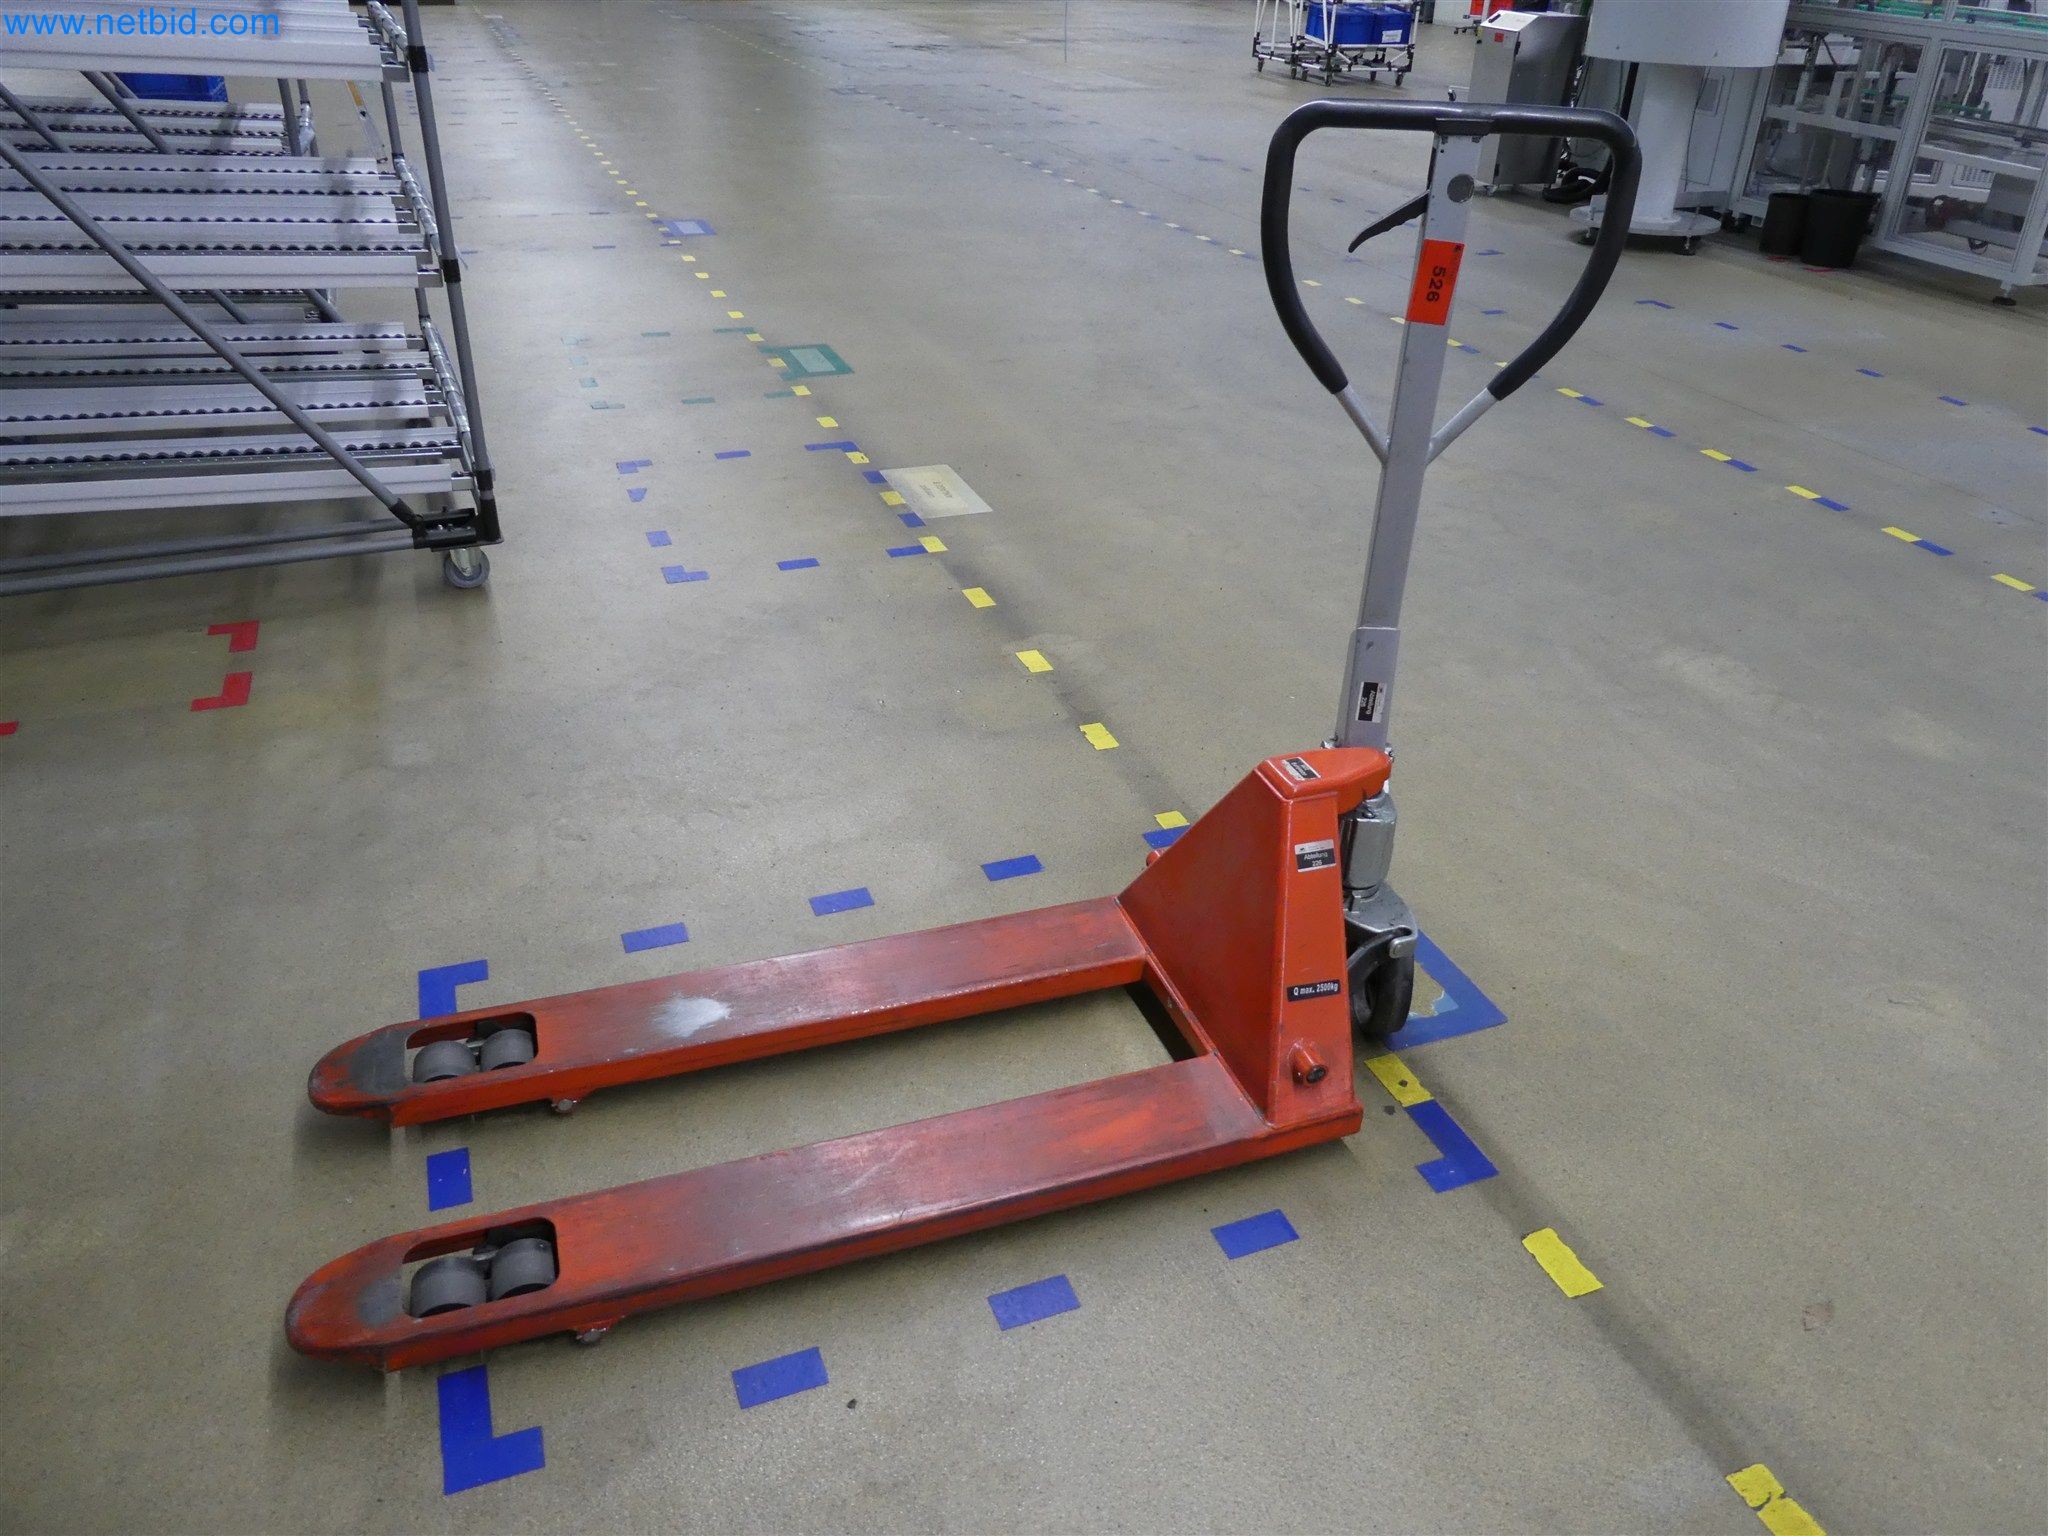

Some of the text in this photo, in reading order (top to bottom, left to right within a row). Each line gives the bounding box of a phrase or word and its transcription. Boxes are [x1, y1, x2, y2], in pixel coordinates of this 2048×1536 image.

[1426, 265, 1446, 301] 526
[1293, 987, 1299, 996] Q
[1316, 982, 1338, 992] 2500kg
